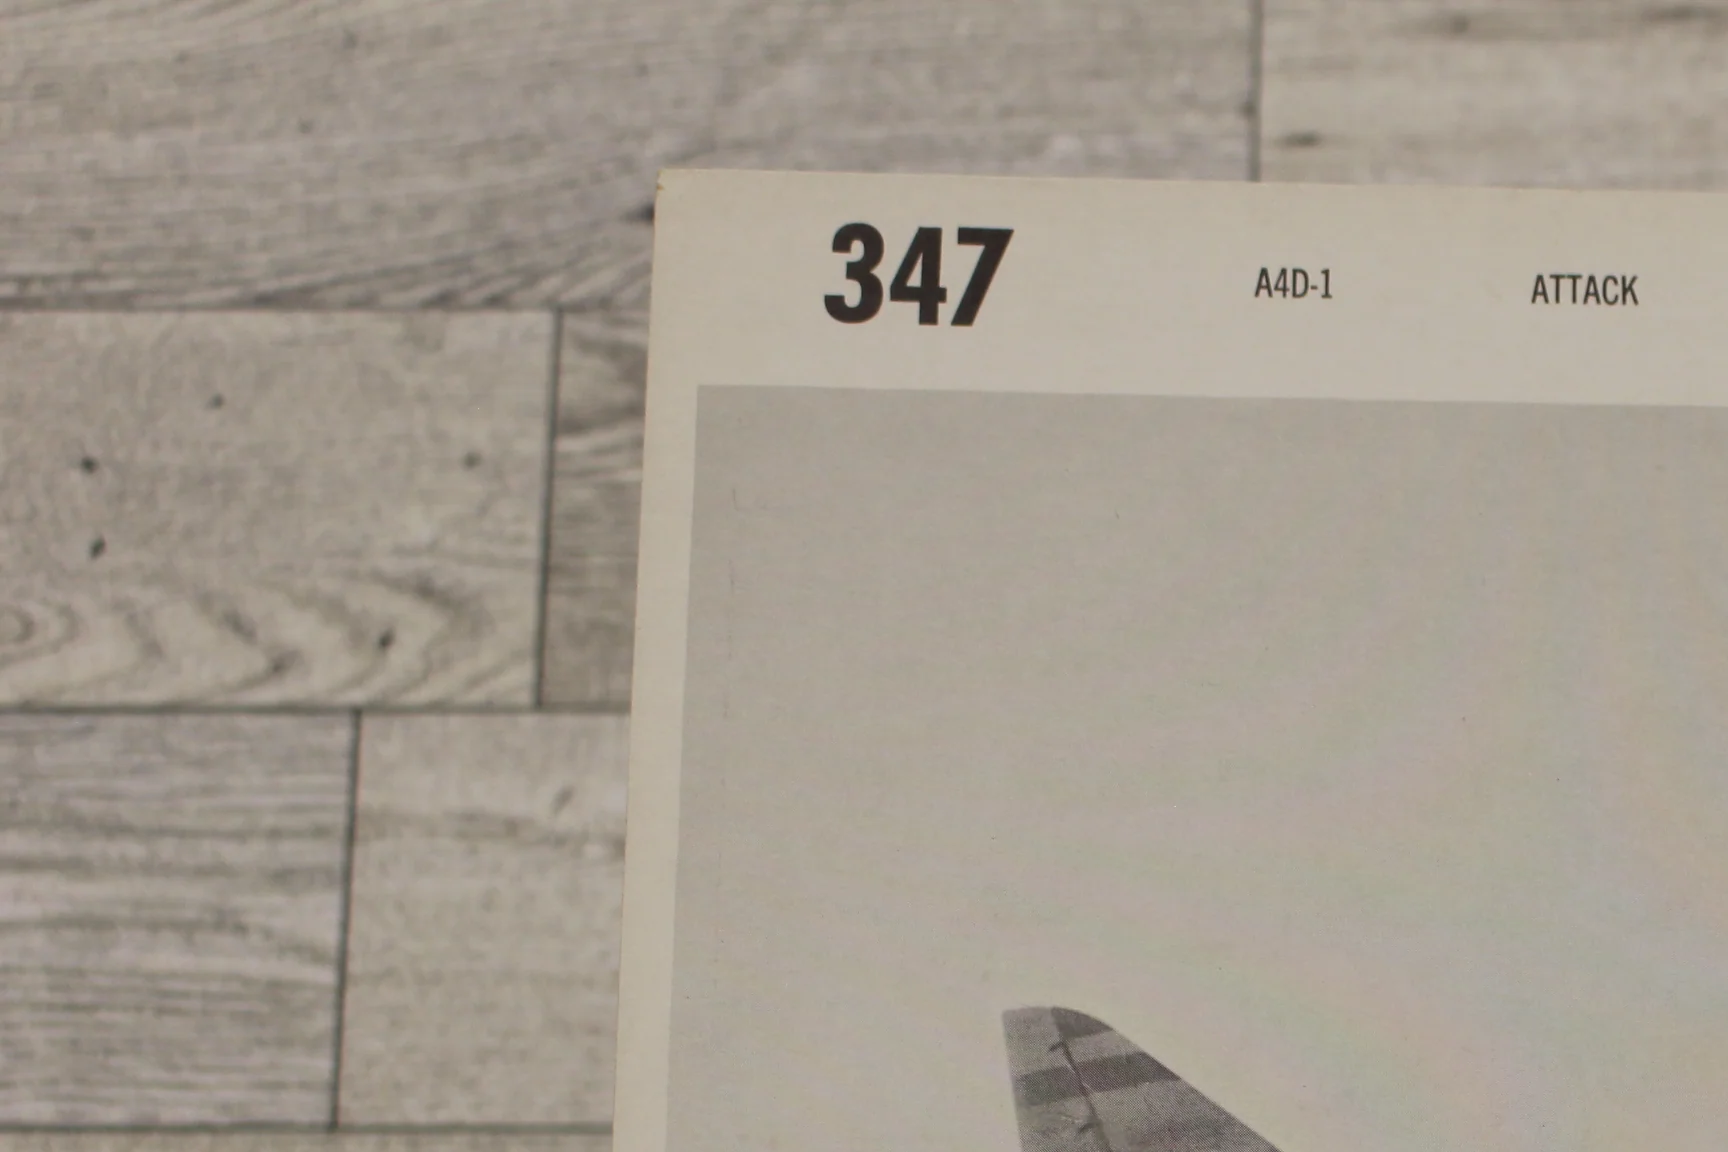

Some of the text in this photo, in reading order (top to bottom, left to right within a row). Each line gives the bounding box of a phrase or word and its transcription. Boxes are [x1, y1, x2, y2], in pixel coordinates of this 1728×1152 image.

[823, 222, 1015, 327] 347
[1254, 267, 1333, 299] A4D-1
[1531, 273, 1639, 306] ATTACK
